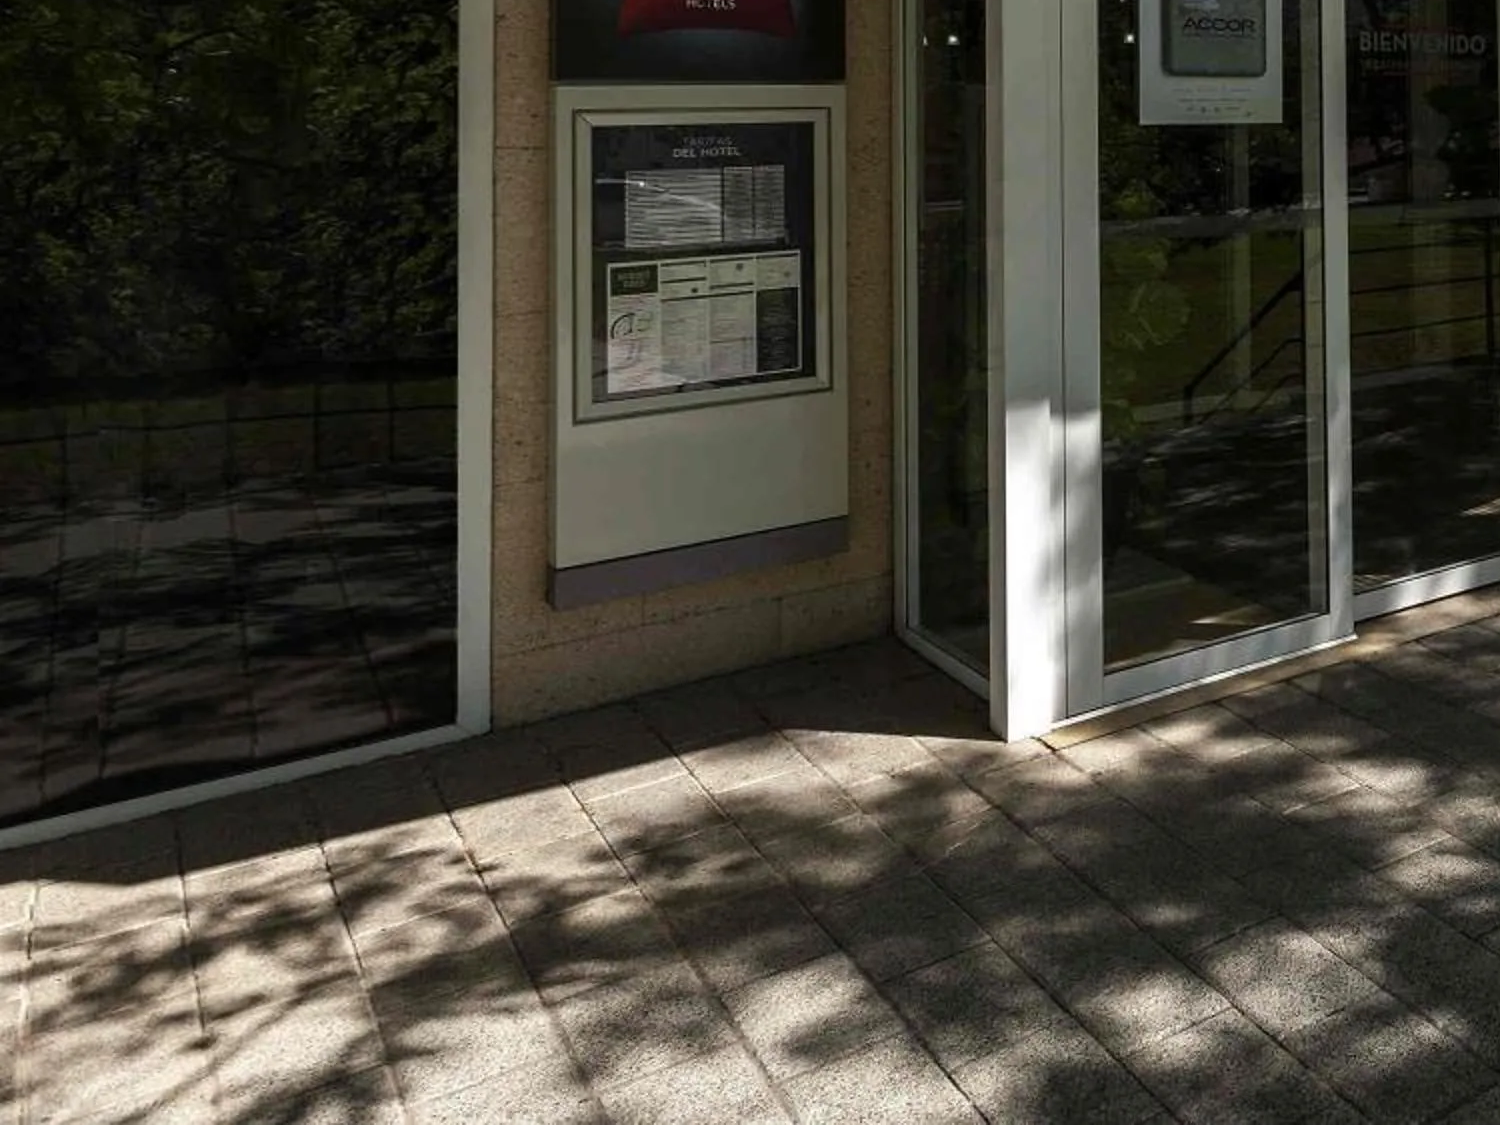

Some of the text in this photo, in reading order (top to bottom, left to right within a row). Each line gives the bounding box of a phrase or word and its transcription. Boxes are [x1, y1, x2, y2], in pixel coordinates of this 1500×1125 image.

[1183, 16, 1257, 36] ACCOR
[1359, 30, 1487, 56] BIENVENIDO
[672, 146, 742, 159] DEL HOTEL
